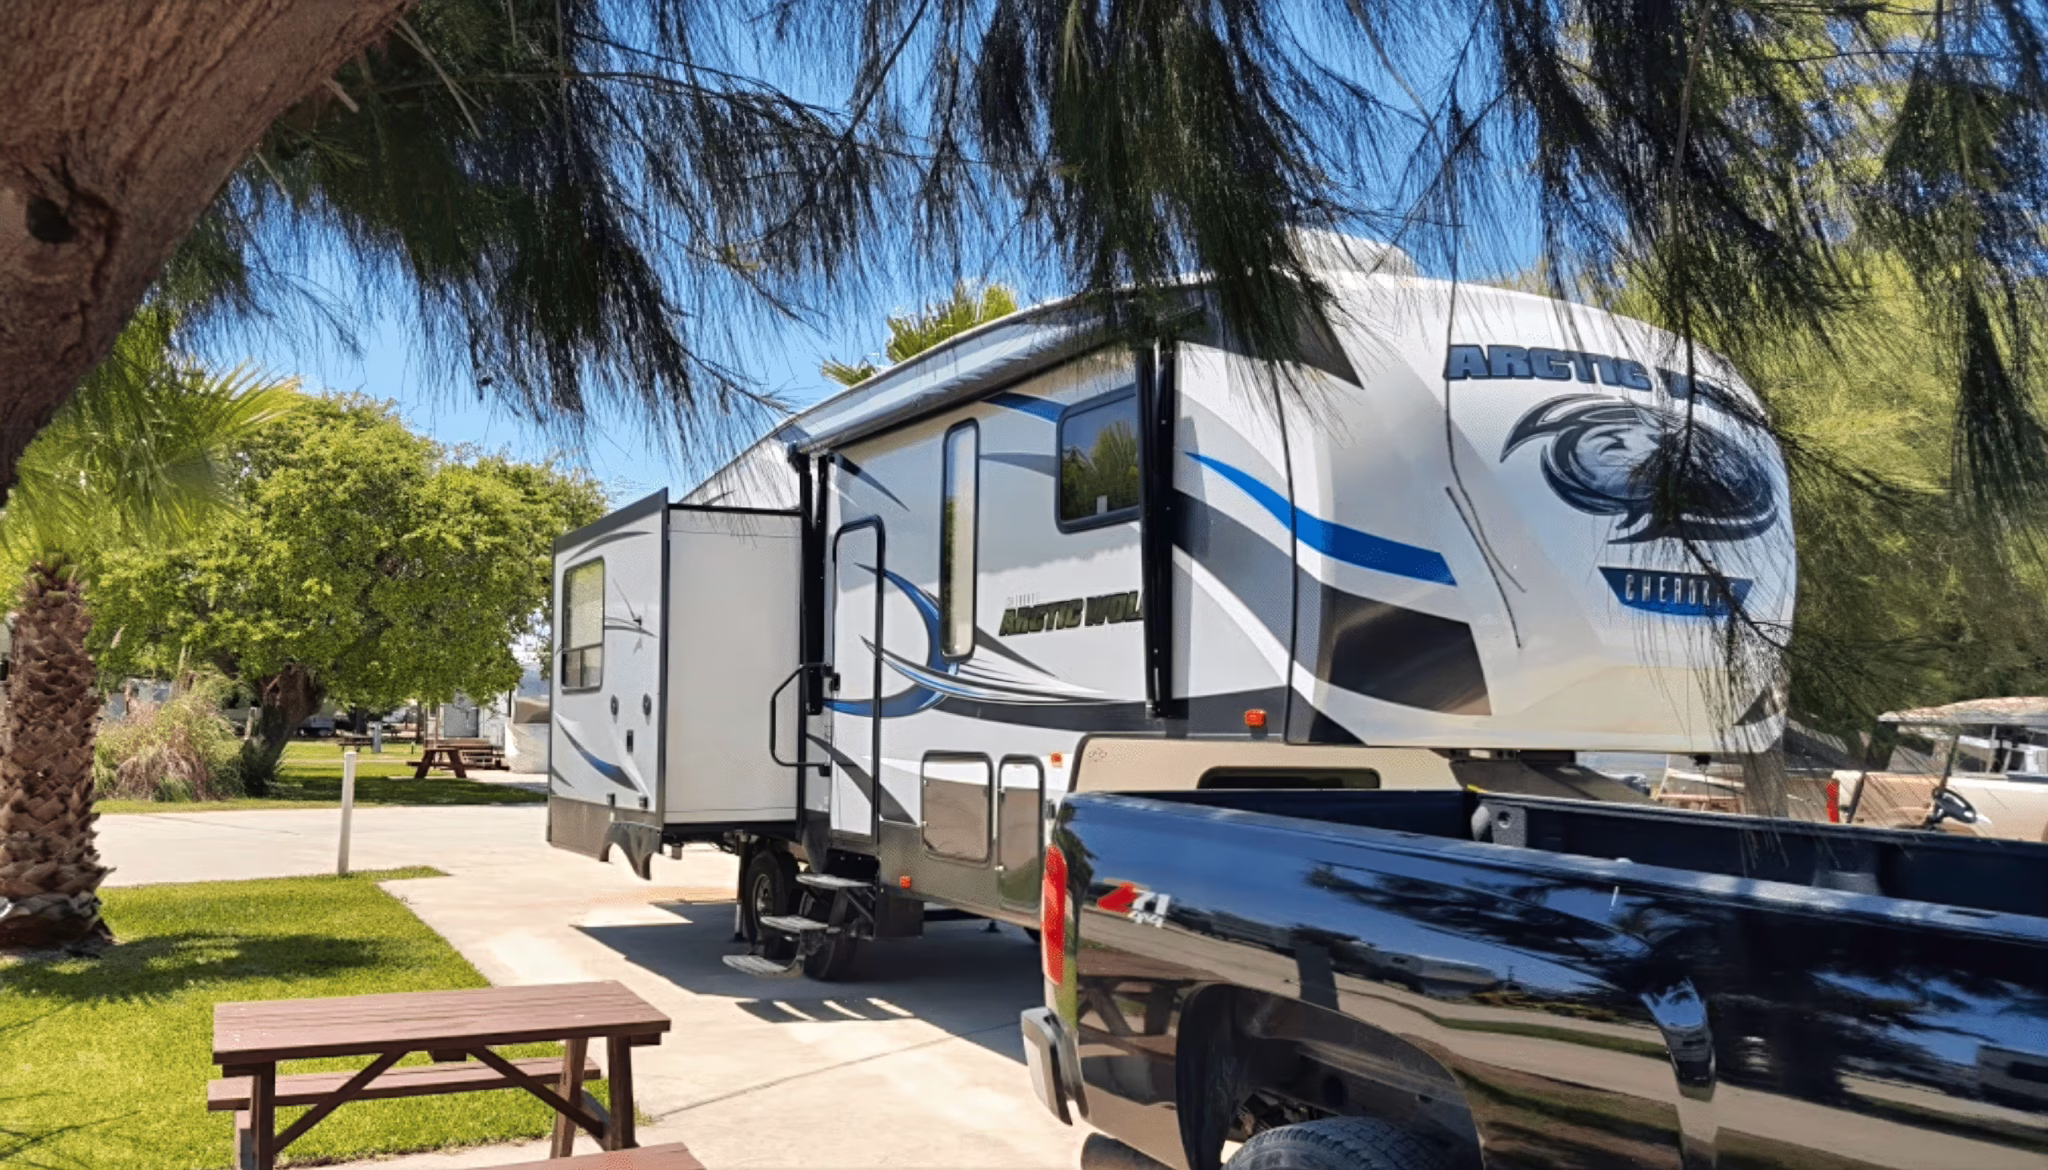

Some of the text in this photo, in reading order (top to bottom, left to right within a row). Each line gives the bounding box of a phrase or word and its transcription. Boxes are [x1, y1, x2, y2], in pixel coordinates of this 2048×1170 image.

[1443, 344, 1652, 391] ARCTIC
[999, 598, 1084, 636] ARCTIC
[1084, 590, 1145, 626] WOL
